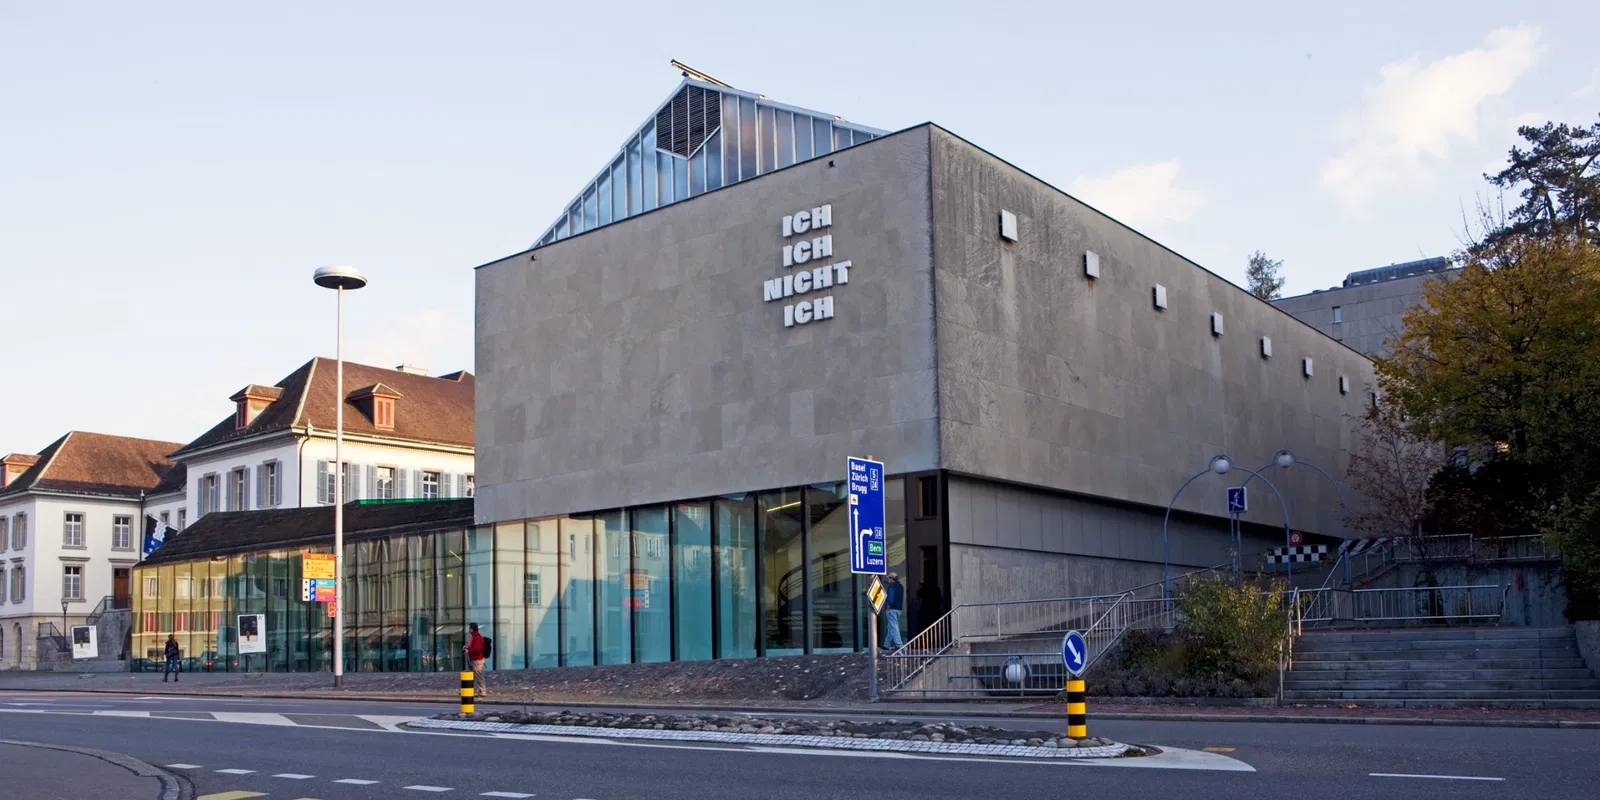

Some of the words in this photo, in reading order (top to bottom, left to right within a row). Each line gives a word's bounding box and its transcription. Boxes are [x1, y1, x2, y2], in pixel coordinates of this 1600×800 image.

[782, 204, 832, 237] ICH
[783, 234, 833, 267] ICH
[764, 260, 852, 302] NICHT
[784, 295, 834, 327] ICH
[851, 461, 866, 472] Basel
[852, 472, 868, 482] Zürich
[852, 482, 868, 494] Brugg
[870, 543, 882, 553] Bern
[867, 556, 883, 566] Luzern
